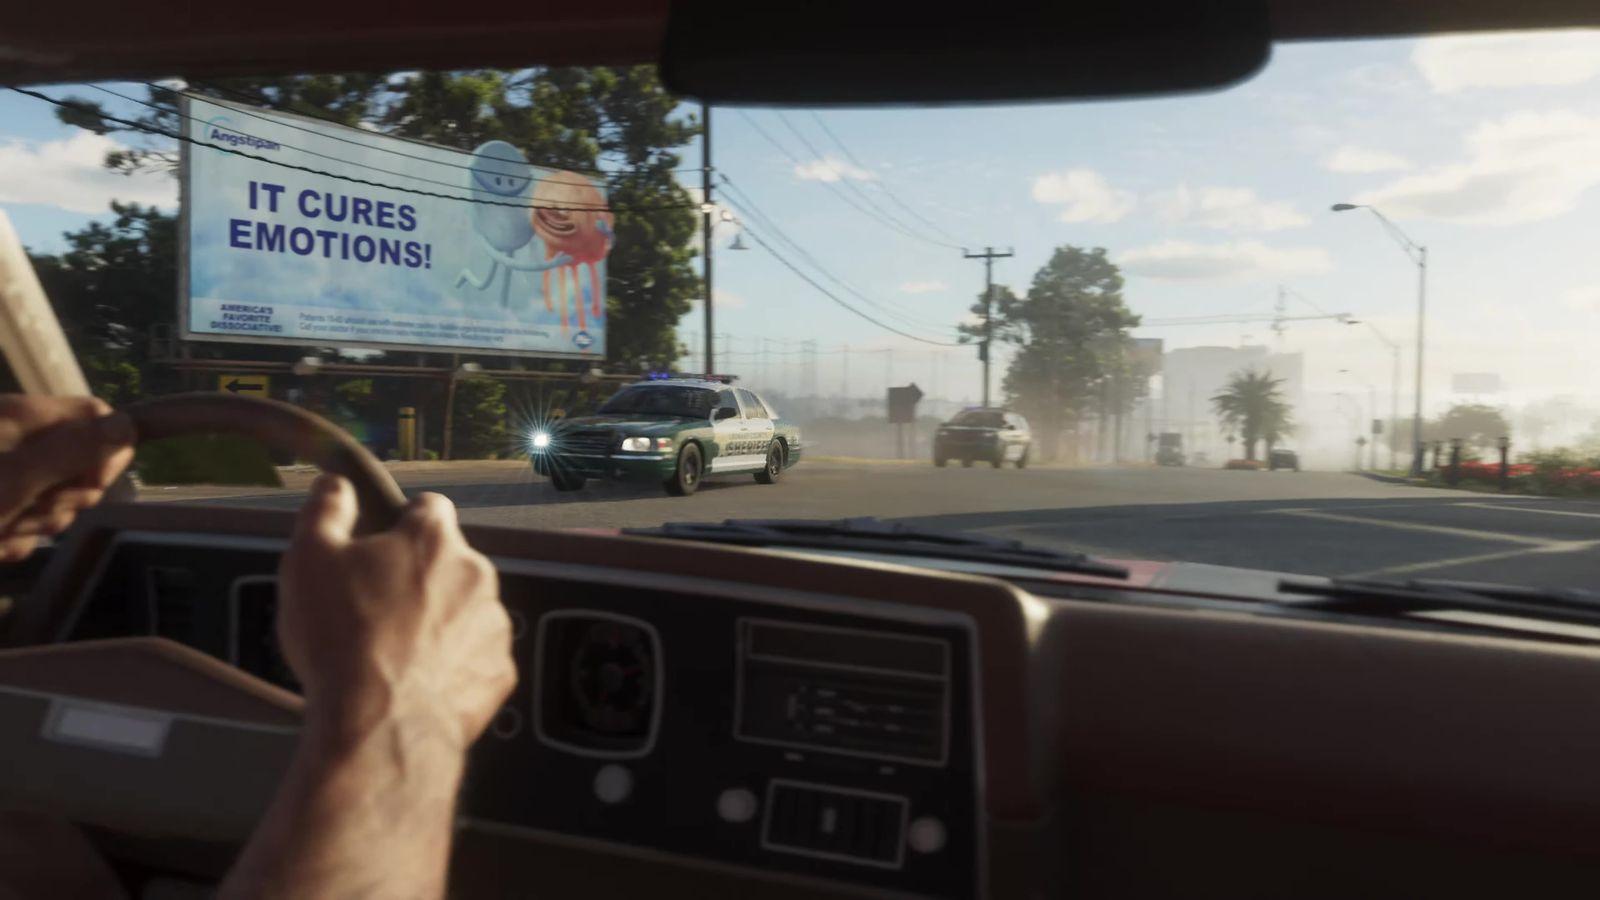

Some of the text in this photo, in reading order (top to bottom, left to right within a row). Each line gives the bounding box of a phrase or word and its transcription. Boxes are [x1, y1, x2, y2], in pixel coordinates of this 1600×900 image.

[211, 128, 281, 151] Angstipan
[249, 181, 417, 232] IT CURES
[229, 218, 432, 270] EMOTIONS!
[223, 312, 271, 323] FAVORITE
